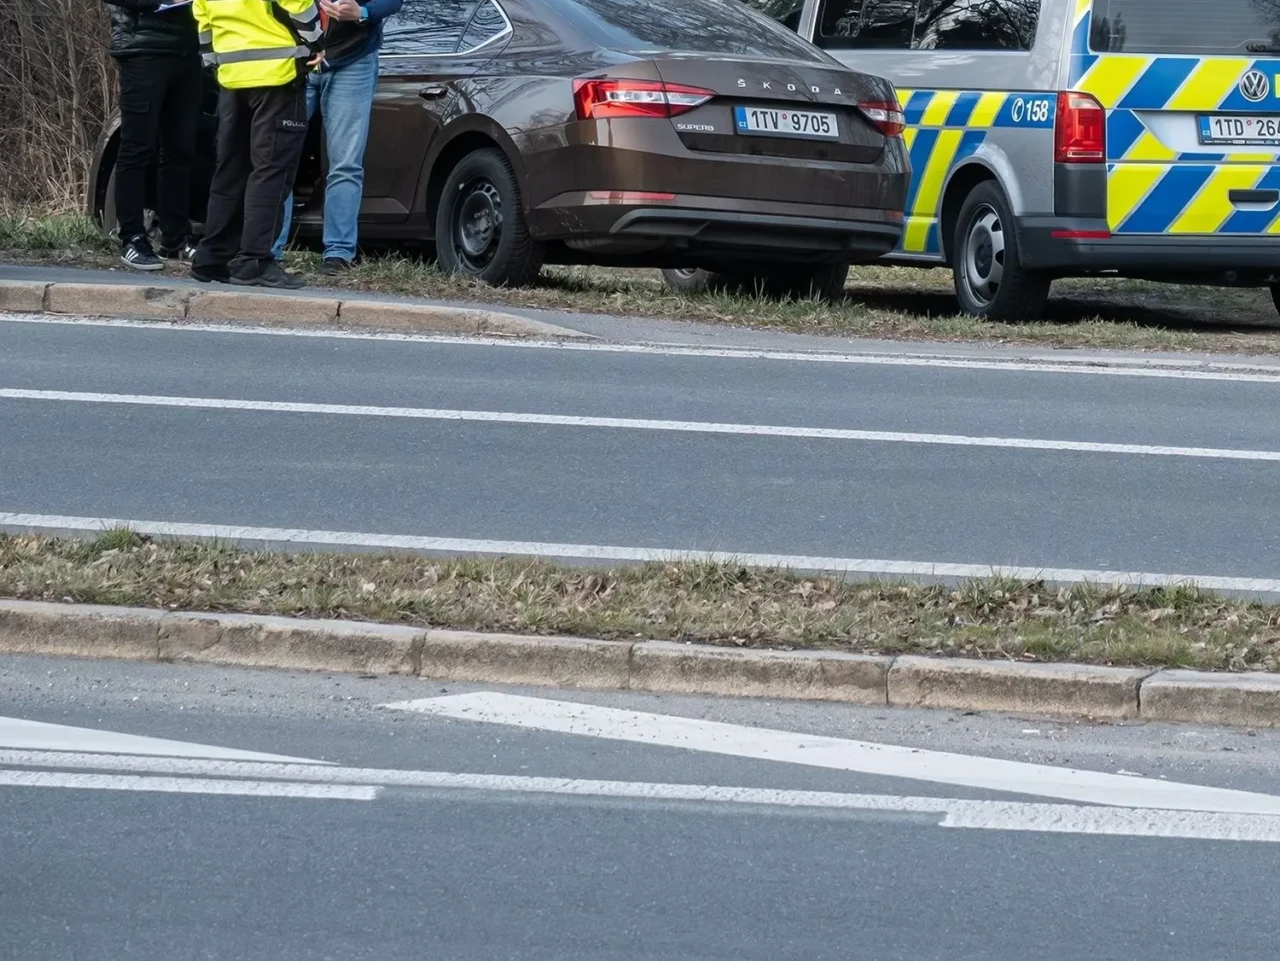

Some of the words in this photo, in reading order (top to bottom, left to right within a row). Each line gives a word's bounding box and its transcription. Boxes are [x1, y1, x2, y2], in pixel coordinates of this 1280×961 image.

[1026, 100, 1049, 122] 158
[677, 123, 715, 132] SUPERB
[752, 111, 778, 129] 1TV
[791, 113, 830, 133] 9705
[1215, 119, 1244, 136] 1TD
